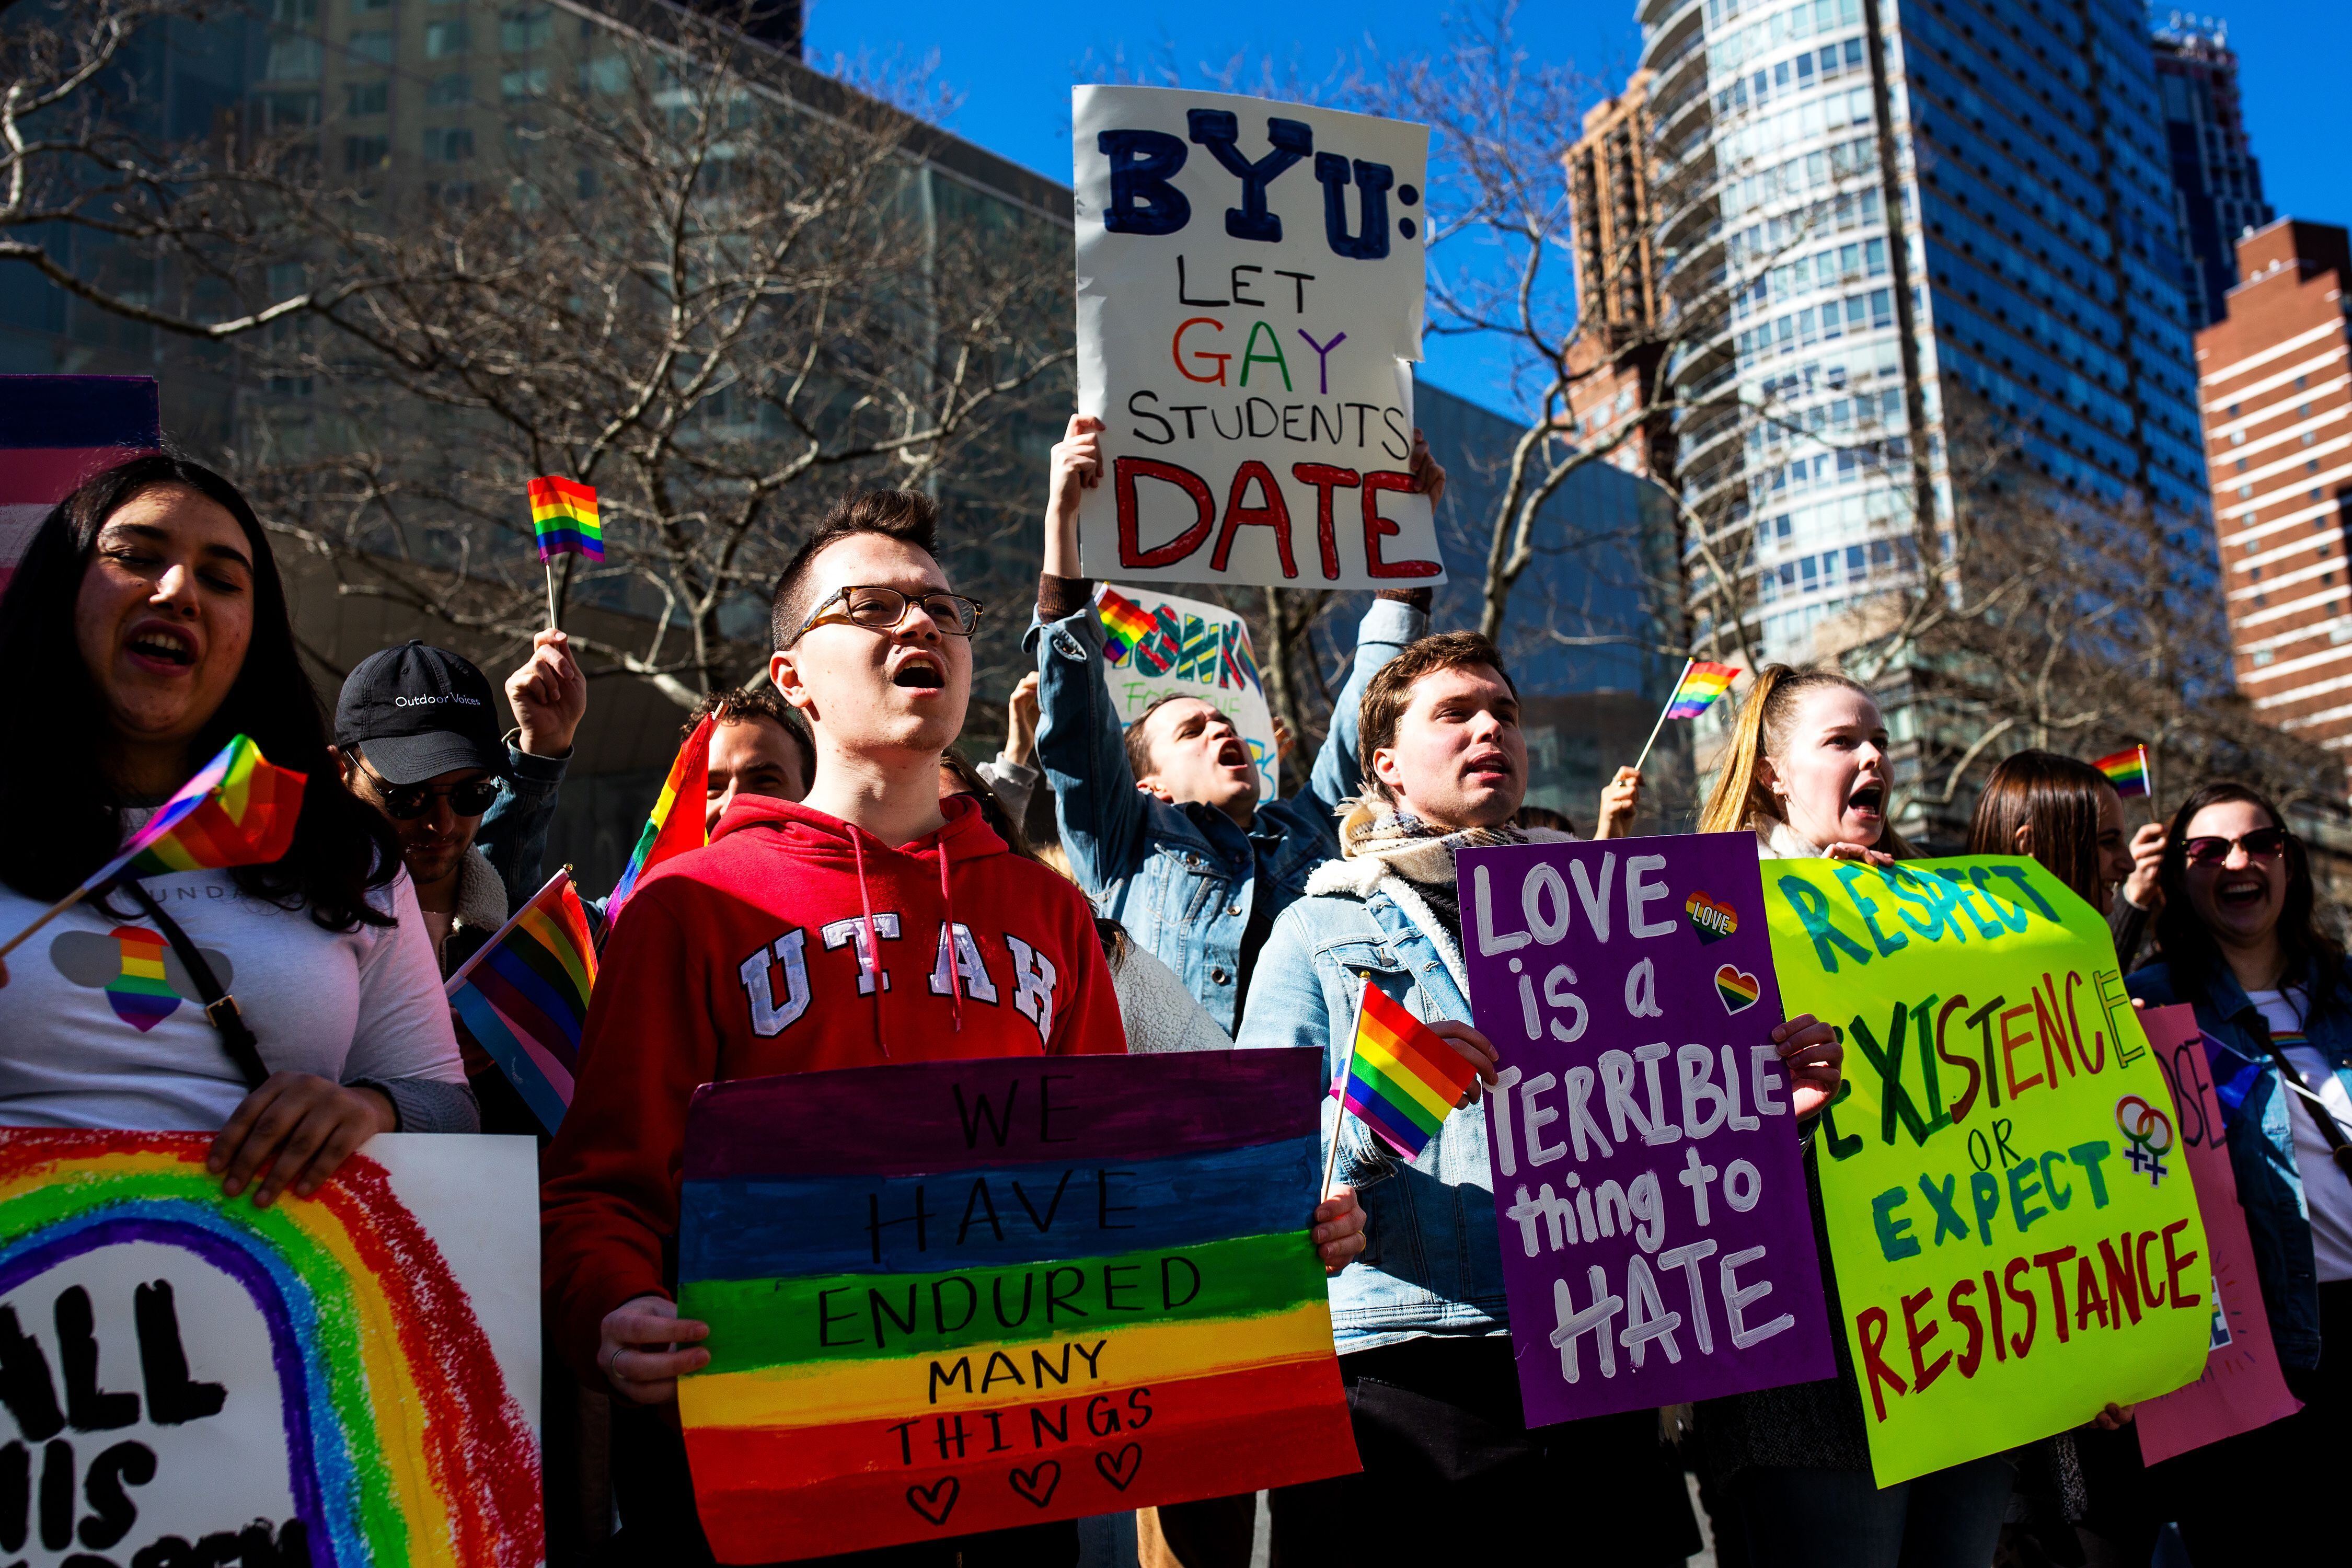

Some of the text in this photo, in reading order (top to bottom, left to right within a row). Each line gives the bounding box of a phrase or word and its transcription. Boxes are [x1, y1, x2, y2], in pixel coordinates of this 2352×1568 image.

[1098, 109, 1419, 260] BYU:
[1177, 255, 1315, 313] LET
[1172, 317, 1347, 394] GAY
[1128, 390, 1410, 460] STUDENTS
[1114, 456, 1443, 580] DATE
[1112, 599, 1247, 690] ONK
[395, 692, 480, 707] Outdoor Voices
[1474, 850, 1677, 956] LOVE
[1692, 902, 1730, 935] LOVE
[1778, 863, 2062, 974] RESPECT
[737, 912, 1057, 1050] UTAH
[1625, 956, 1664, 1018] a
[952, 1075, 1079, 1148] WE
[1484, 1041, 1786, 1177] TERRIBLE
[1967, 1118, 2021, 1171] OR
[864, 1169, 1137, 1264] HAVE
[1505, 1146, 1762, 1257] thing to
[1872, 1140, 2111, 1262] EXPECT
[818, 1256, 1201, 1348] ENDURED
[1549, 1238, 1795, 1384] HATE
[1856, 1218, 2201, 1423] RESISTANCE
[929, 1339, 1108, 1404] MANY
[886, 1387, 1152, 1465] THINGS
